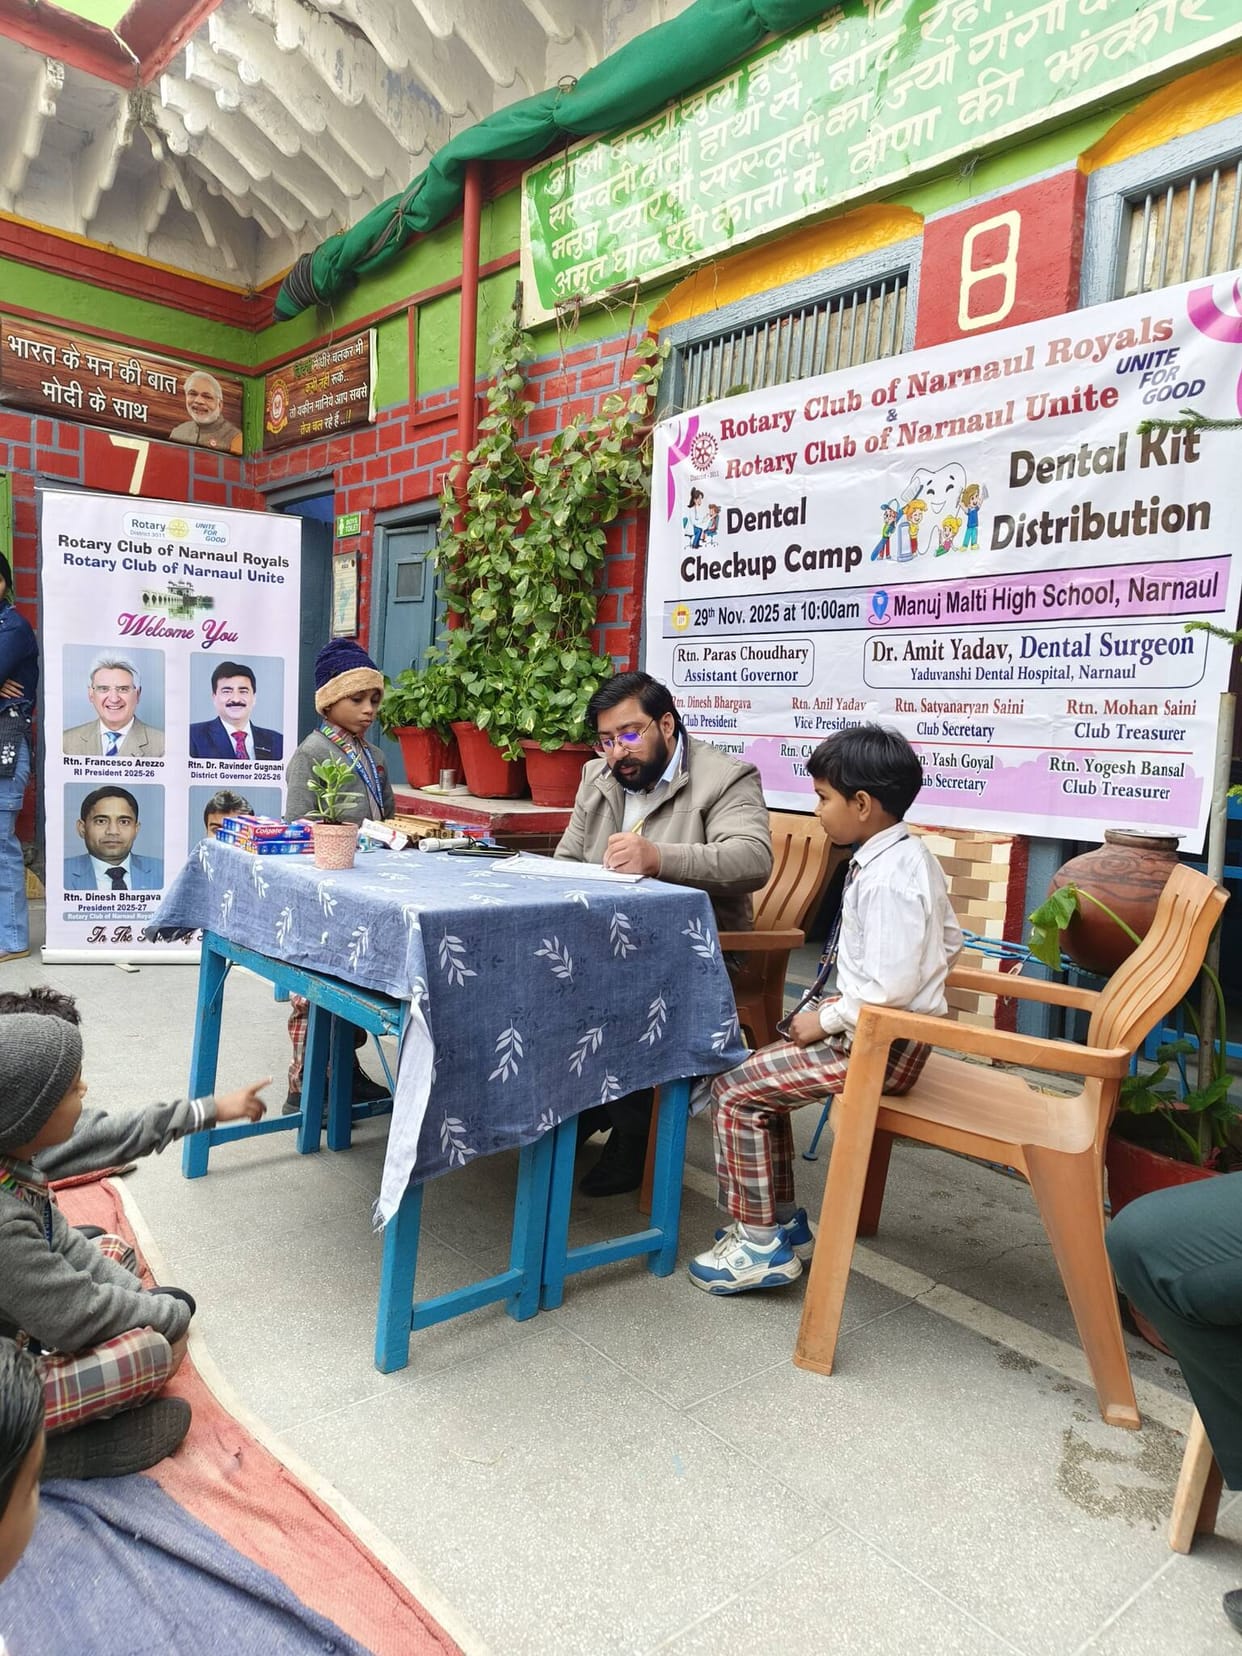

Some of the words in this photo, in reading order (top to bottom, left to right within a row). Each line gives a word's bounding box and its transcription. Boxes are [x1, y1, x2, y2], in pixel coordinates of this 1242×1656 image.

[957, 67, 1025, 126] की
[957, 209, 1022, 331] 8
[8, 335, 56, 366] भारत
[61, 344, 81, 370] के
[86, 354, 113, 379] मन
[119, 359, 142, 386] की
[147, 370, 178, 395] बात
[1116, 346, 1181, 376] UNITE
[720, 409, 797, 441] Rotary
[804, 390, 862, 422] Club
[871, 377, 901, 405] of
[906, 345, 1035, 400] Narnaul
[1045, 315, 1174, 366] Royals
[1138, 365, 1180, 390] FOR
[41, 376, 83, 408] मोदी
[88, 387, 107, 413] के
[112, 397, 148, 423] साथ
[349, 382, 368, 400] सबसे
[1142, 378, 1206, 406] GOOD
[886, 408, 898, 422] &
[725, 451, 797, 480] Rotary
[804, 436, 857, 466] Club
[865, 426, 892, 454] of
[896, 400, 1015, 449] Narnaul
[1025, 383, 1119, 422] Unite
[108, 434, 150, 495] 7
[1009, 431, 1129, 489] Dental
[1139, 424, 1201, 469] Kit
[131, 519, 166, 532] Rotary
[196, 522, 216, 530] UNITE
[726, 496, 808, 535] Dental
[990, 495, 1212, 551] Distribution
[58, 534, 112, 554] Rotary
[118, 539, 152, 555] Club
[158, 544, 175, 557] of
[179, 546, 238, 563] Narnaul
[243, 552, 290, 569] Royals
[63, 552, 117, 571] Rotary
[122, 558, 157, 573] Club
[162, 562, 179, 574] of
[183, 564, 242, 580] Narnaul
[248, 569, 285, 584] Unite
[680, 551, 777, 583] Checkup
[784, 543, 863, 573] Camp
[893, 592, 941, 620] Manuj
[946, 587, 986, 613] Malti
[992, 585, 1036, 615] High
[1042, 579, 1121, 608] School,
[1128, 571, 1219, 603] Narnaul
[694, 606, 716, 626] 29th
[718, 606, 746, 625] Nov.
[750, 603, 780, 623] 2025
[783, 605, 796, 622] at
[801, 600, 860, 621] 10:00am
[117, 612, 195, 641] Welcome
[201, 619, 239, 649] You
[678, 648, 700, 663] Rtn.
[703, 647, 737, 662] Paras
[740, 644, 809, 665] Choudhary
[871, 640, 898, 662] Dr.
[902, 639, 945, 662] Amit
[950, 637, 1013, 664] Yadav,
[1019, 632, 1091, 659] Dental
[1099, 631, 1194, 666] Surgeon
[684, 667, 738, 683] Assistant
[740, 667, 799, 683] Governor
[910, 667, 972, 681] Yaduvanshi
[975, 666, 1014, 681] Dental
[1018, 664, 1075, 685] Hospital,
[1079, 663, 1136, 680] Narnaul
[688, 695, 712, 709] Dinesh
[714, 695, 752, 714] Bhargava
[792, 697, 811, 710] Rtn.
[812, 697, 833, 710] Anil
[836, 697, 867, 711] Yadav
[895, 697, 918, 713] Rtn.
[920, 697, 989, 719] Satyanaryan
[992, 698, 1025, 715] Saini
[1066, 699, 1098, 716] Rtn.
[1103, 699, 1159, 716] Mohan
[1163, 699, 1197, 716] Saini
[681, 713, 699, 727] Club
[700, 714, 737, 728] President
[794, 715, 814, 729] Vice
[916, 721, 940, 736] Club
[942, 720, 995, 743] Secretary
[1074, 722, 1111, 739] Club
[1116, 723, 1187, 741] Treasurer
[780, 743, 799, 757] Rtn.
[63, 757, 82, 766] Rtn.
[84, 757, 132, 767] Francesco
[135, 759, 164, 768] Arezzo
[73, 768, 82, 776] RI
[83, 769, 123, 777] President
[124, 769, 155, 778] 2025-26
[188, 761, 204, 769] Rtn.
[206, 761, 217, 770] Dr.
[219, 761, 252, 770] Ravinder
[253, 762, 285, 773] Gugnani
[932, 752, 957, 768] Yash
[961, 753, 994, 774] Goyal
[1049, 756, 1080, 773] Rtn.
[1084, 758, 1136, 779] Yogesh
[1140, 760, 1185, 778] Bansal
[191, 771, 218, 779] District
[219, 772, 252, 780] Governor
[253, 772, 282, 781] 2025-26
[935, 773, 987, 796] Secretary
[1062, 778, 1097, 796] Club
[1102, 781, 1171, 800] Treasurer
[255, 826, 283, 834] Colgate
[64, 893, 83, 902] Rtn.
[85, 893, 117, 902] Dinesh
[119, 893, 161, 903] Bhargava
[78, 904, 115, 912] President
[87, 925, 107, 943] In
[111, 925, 132, 943] The
